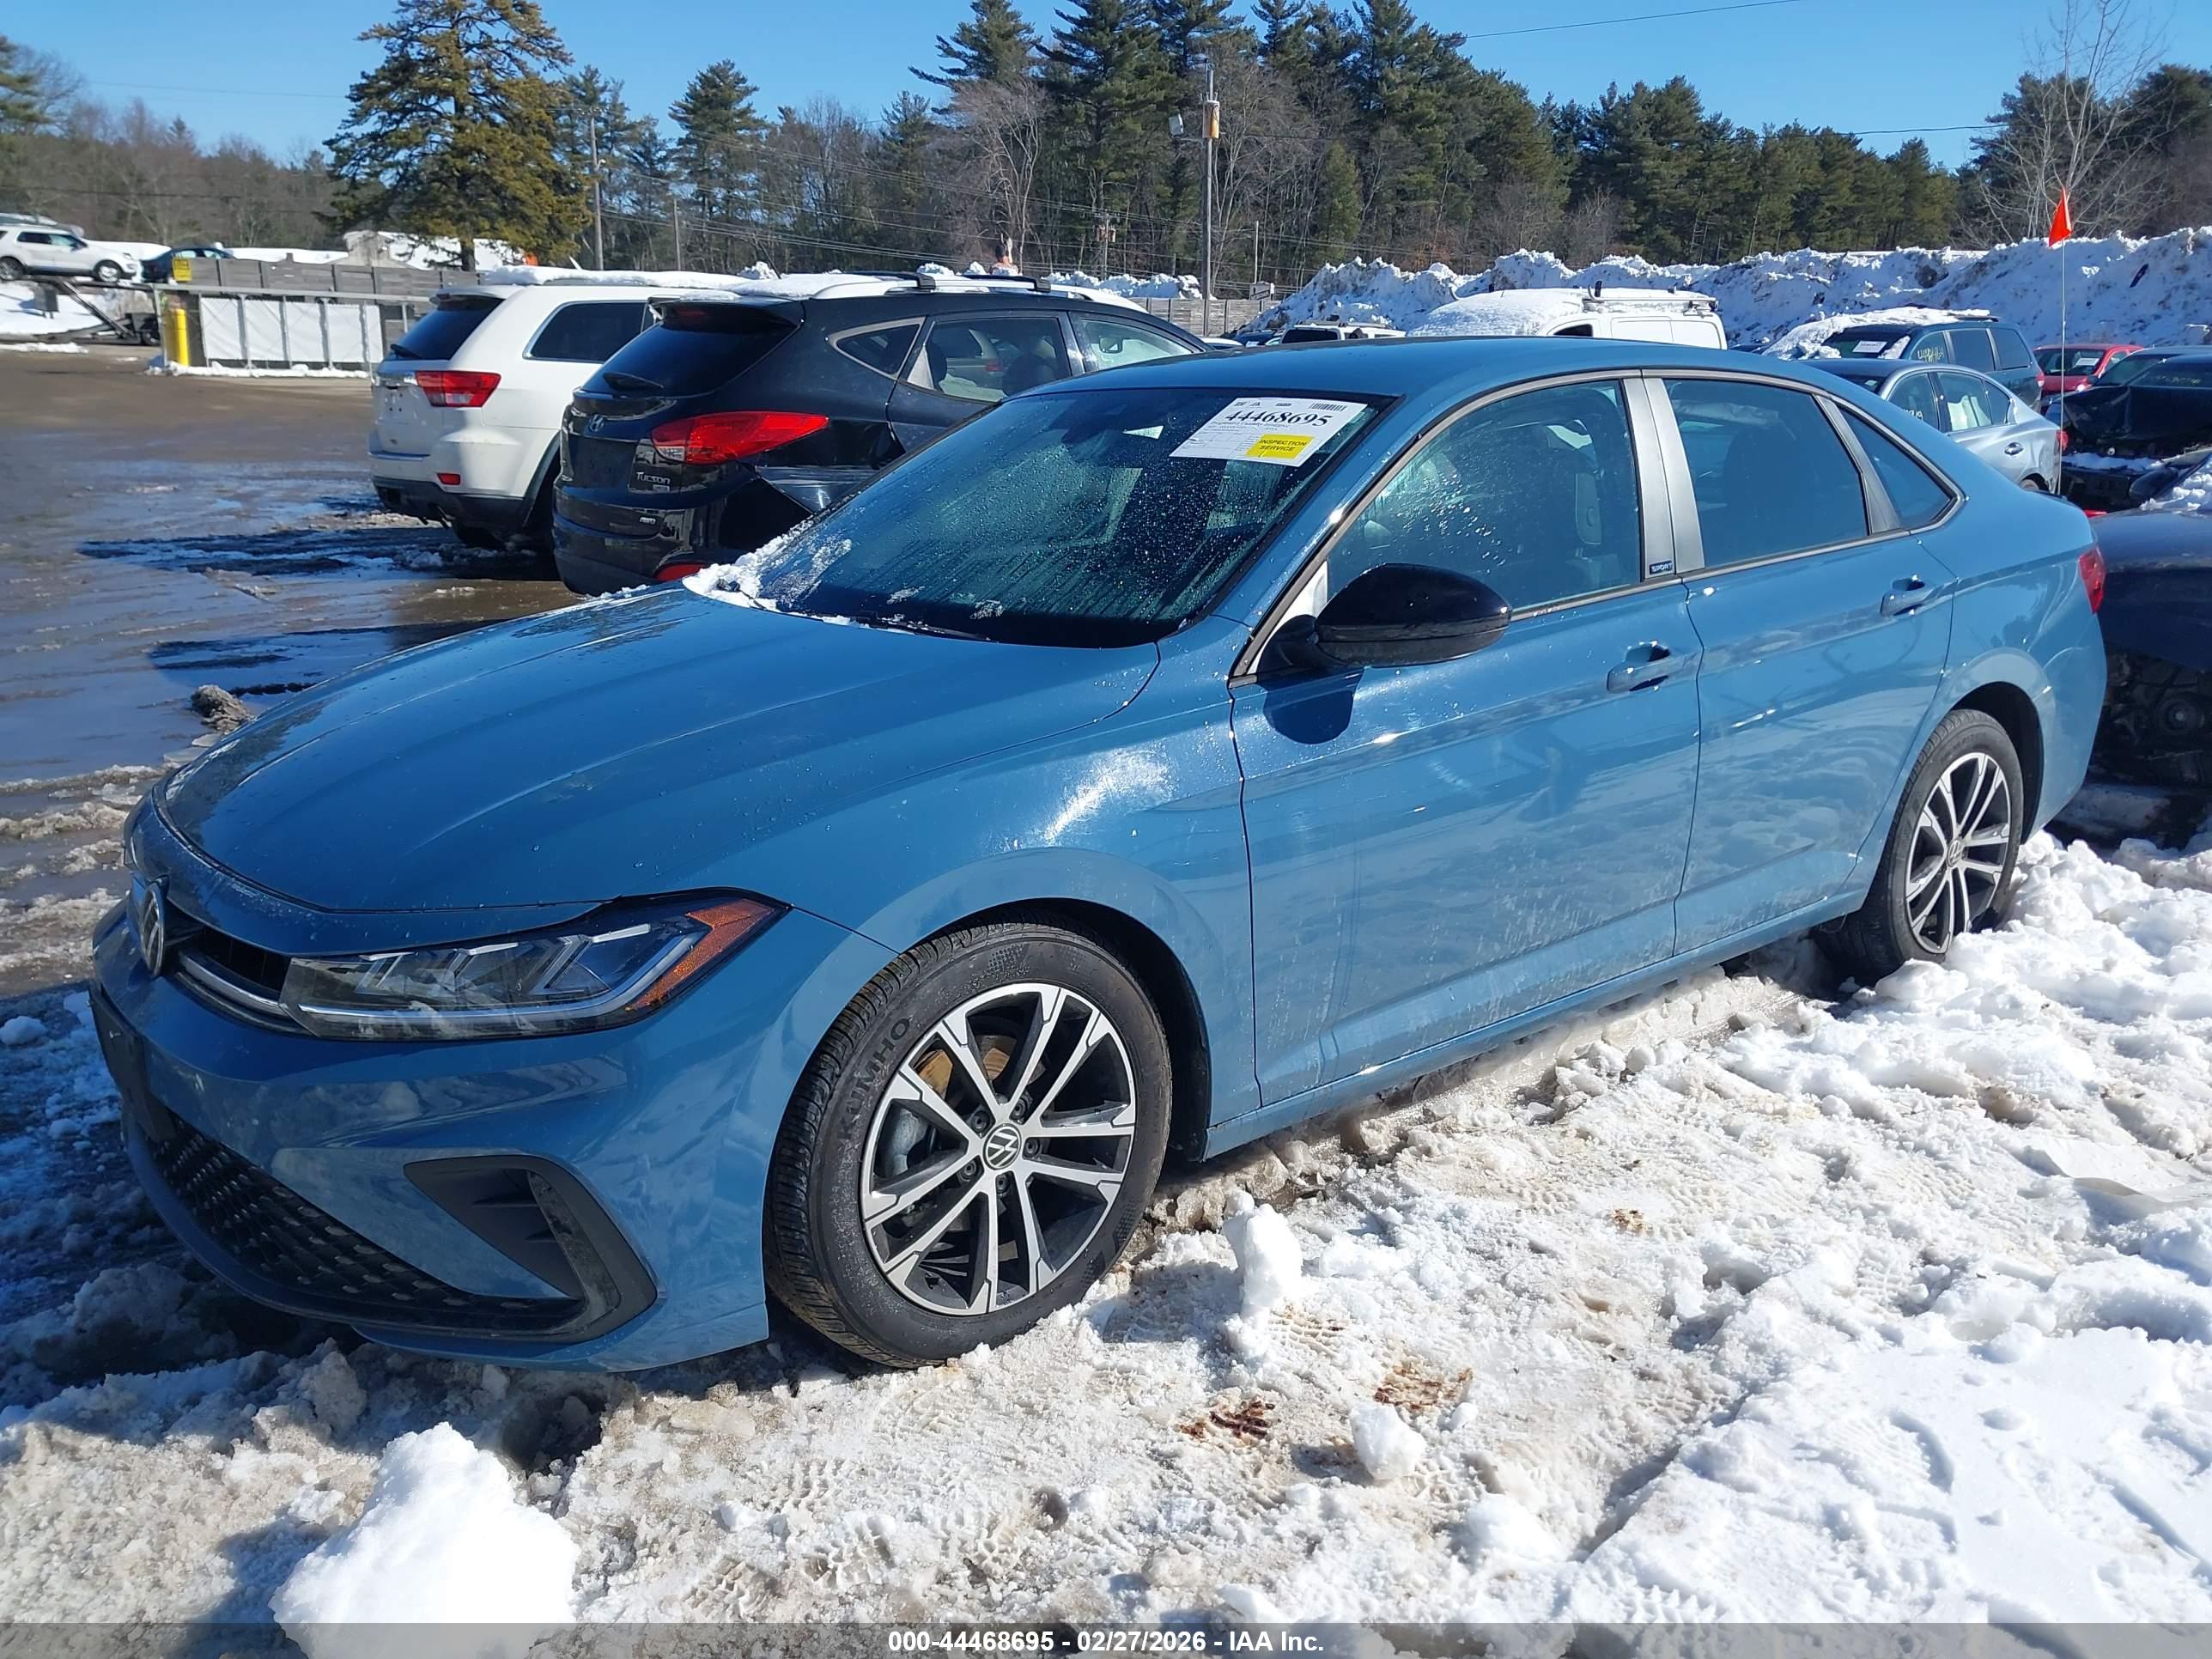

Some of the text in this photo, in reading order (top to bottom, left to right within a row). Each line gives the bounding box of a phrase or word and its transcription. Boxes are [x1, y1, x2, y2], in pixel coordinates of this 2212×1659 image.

[1225, 410, 1333, 427] 44468695
[635, 471, 671, 485] Tucson
[1651, 562, 1673, 573] SPORT
[836, 1018, 910, 1141] KUMHO
